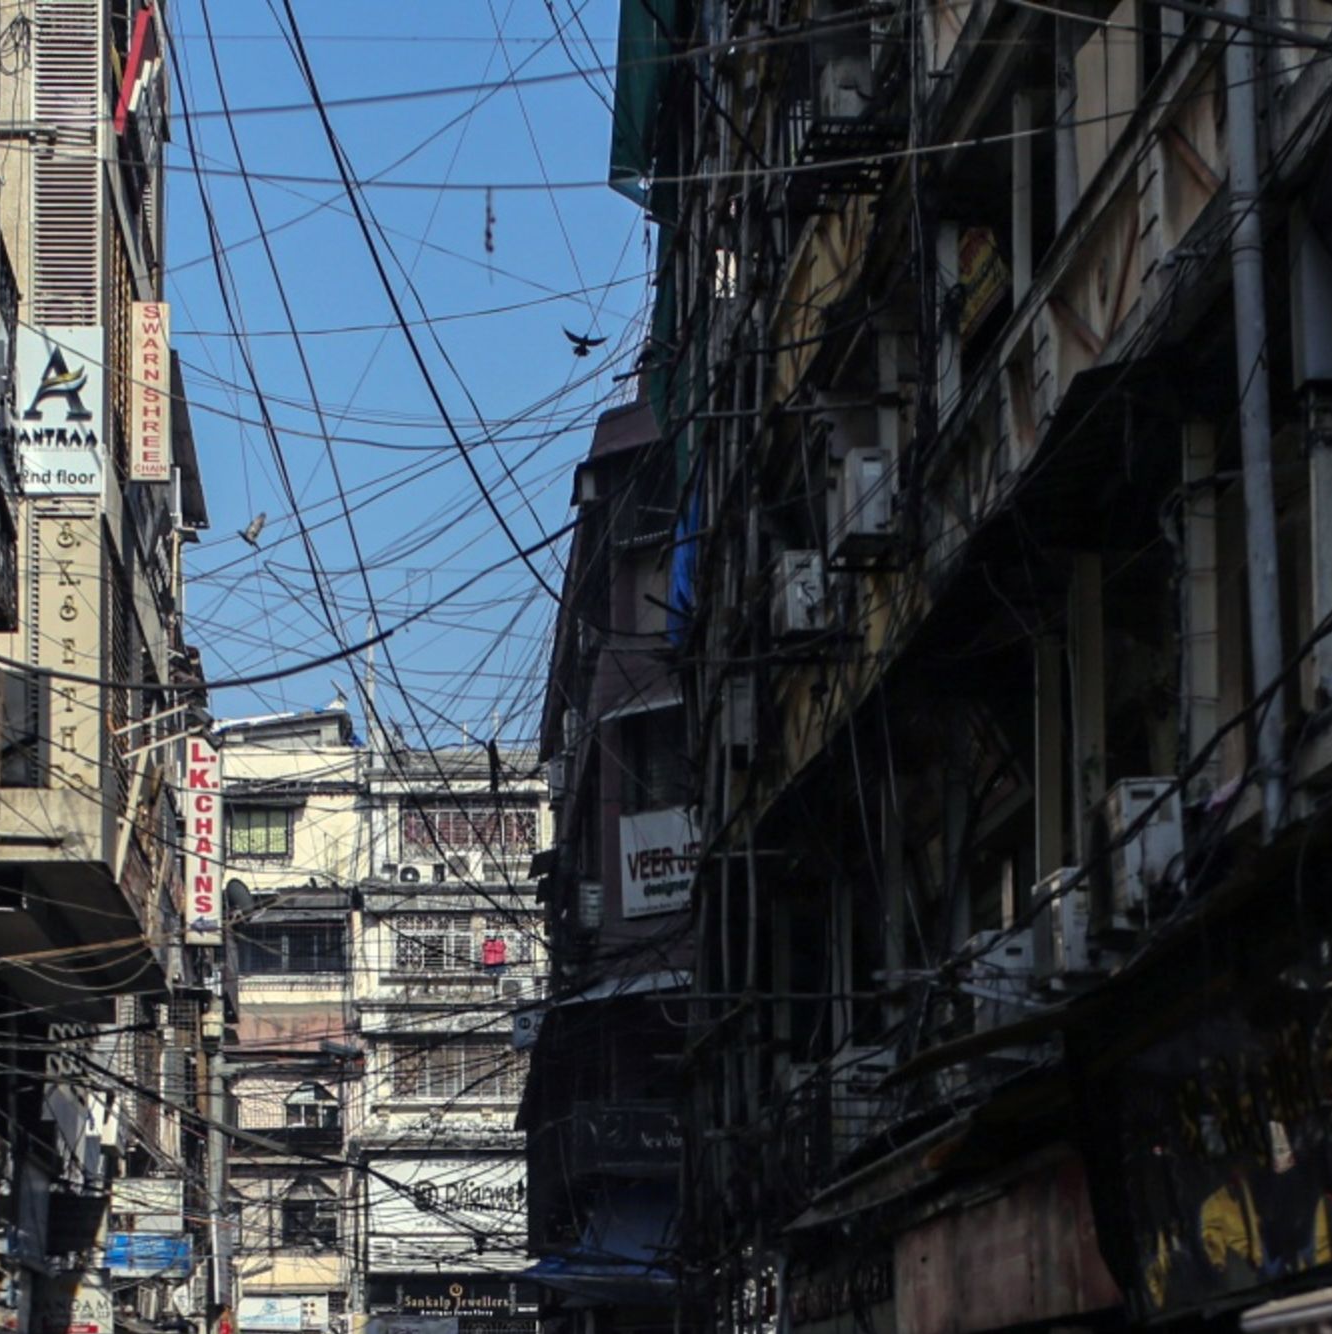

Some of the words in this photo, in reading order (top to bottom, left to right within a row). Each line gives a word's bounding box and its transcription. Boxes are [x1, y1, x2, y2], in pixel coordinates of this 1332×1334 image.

[142, 305, 161, 381] SWARN
[142, 387, 162, 463] SHREE
[56, 469, 96, 484] floor
[133, 463, 167, 474] CHAIN
[627, 846, 675, 882] VEER
[677, 841, 701, 875] JE
[404, 1295, 452, 1310] Sankalp
[454, 1295, 510, 1311] Jewellers
